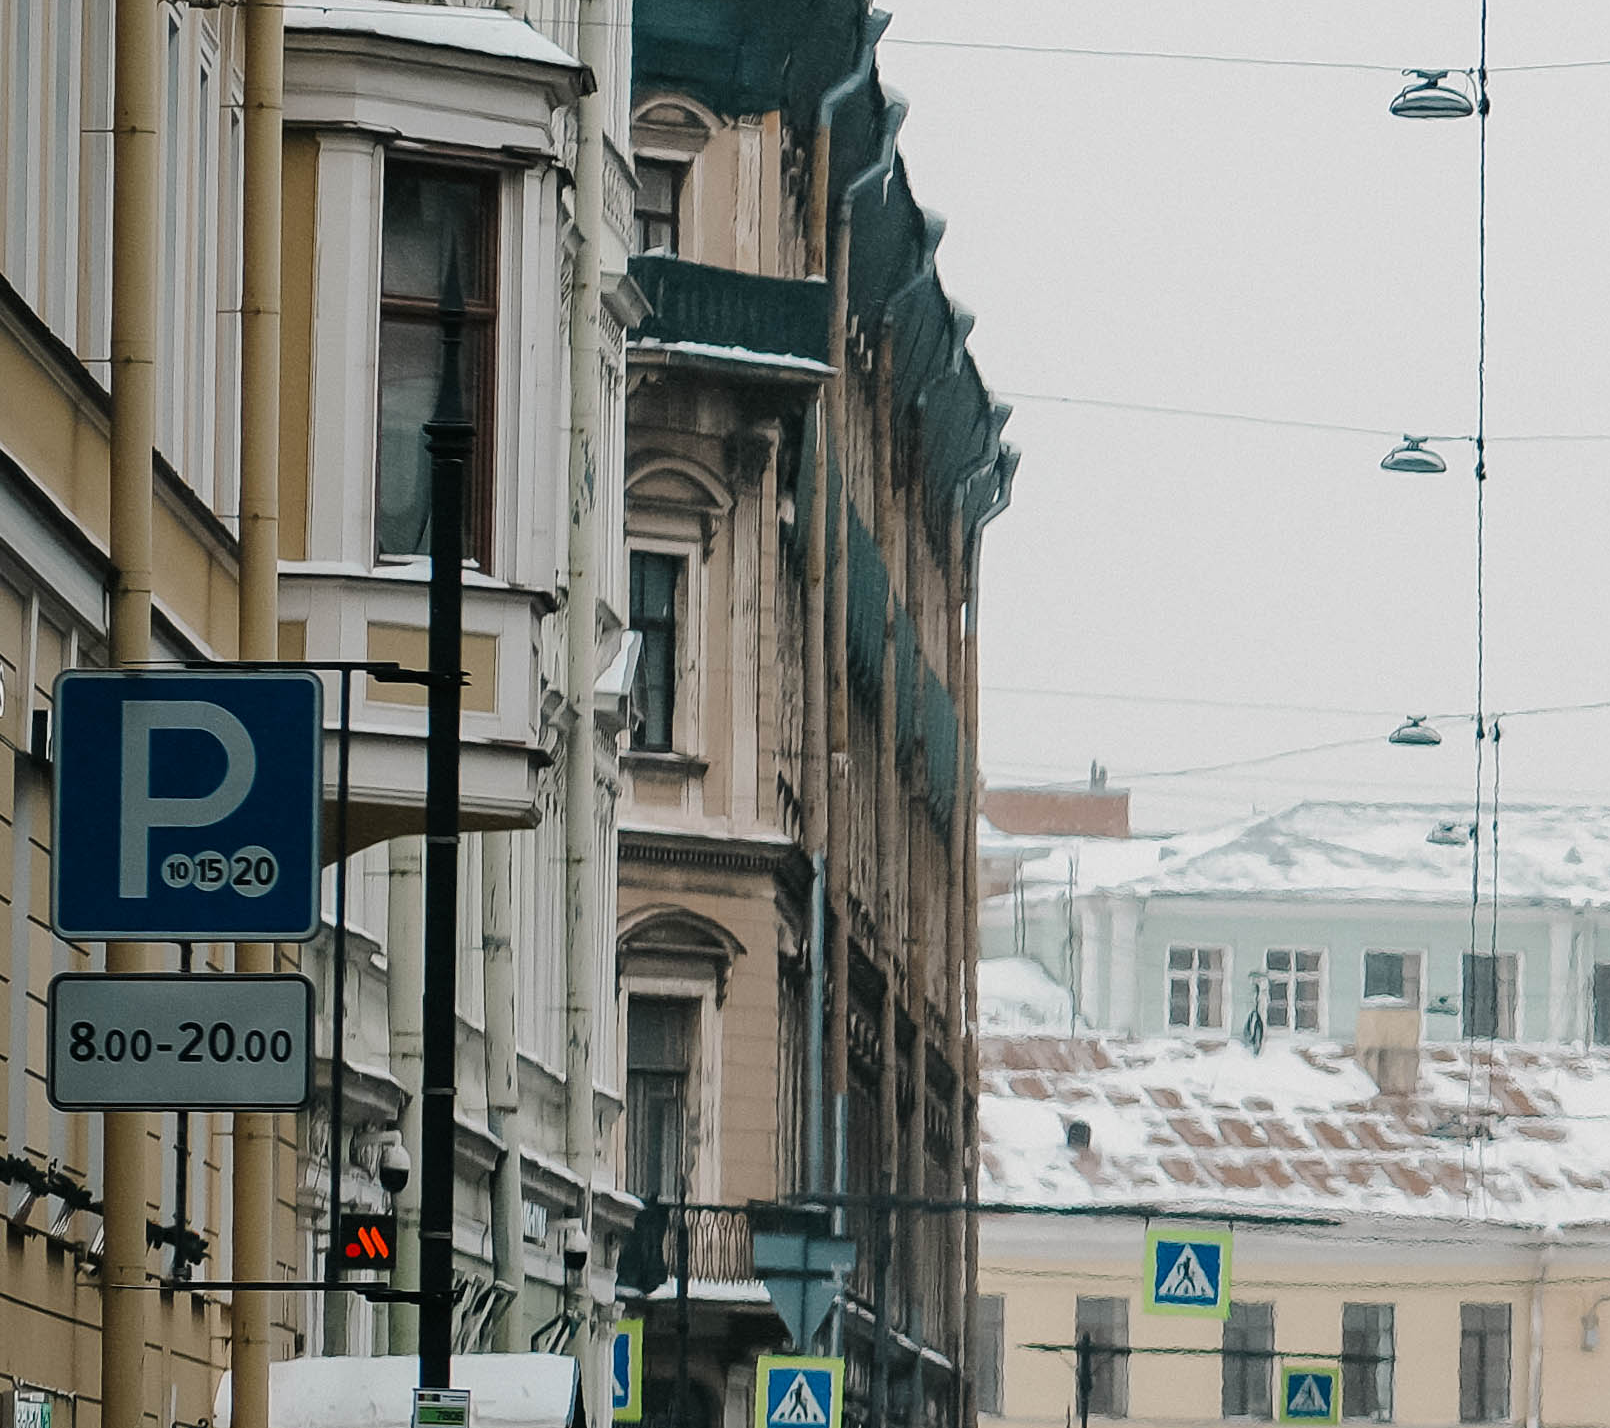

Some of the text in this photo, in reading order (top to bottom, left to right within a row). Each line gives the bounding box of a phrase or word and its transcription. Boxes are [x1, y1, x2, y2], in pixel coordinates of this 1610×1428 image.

[119, 699, 257, 899] P
[167, 855, 274, 887] 10 15 20
[69, 1019, 293, 1064] 8.00-20.00
